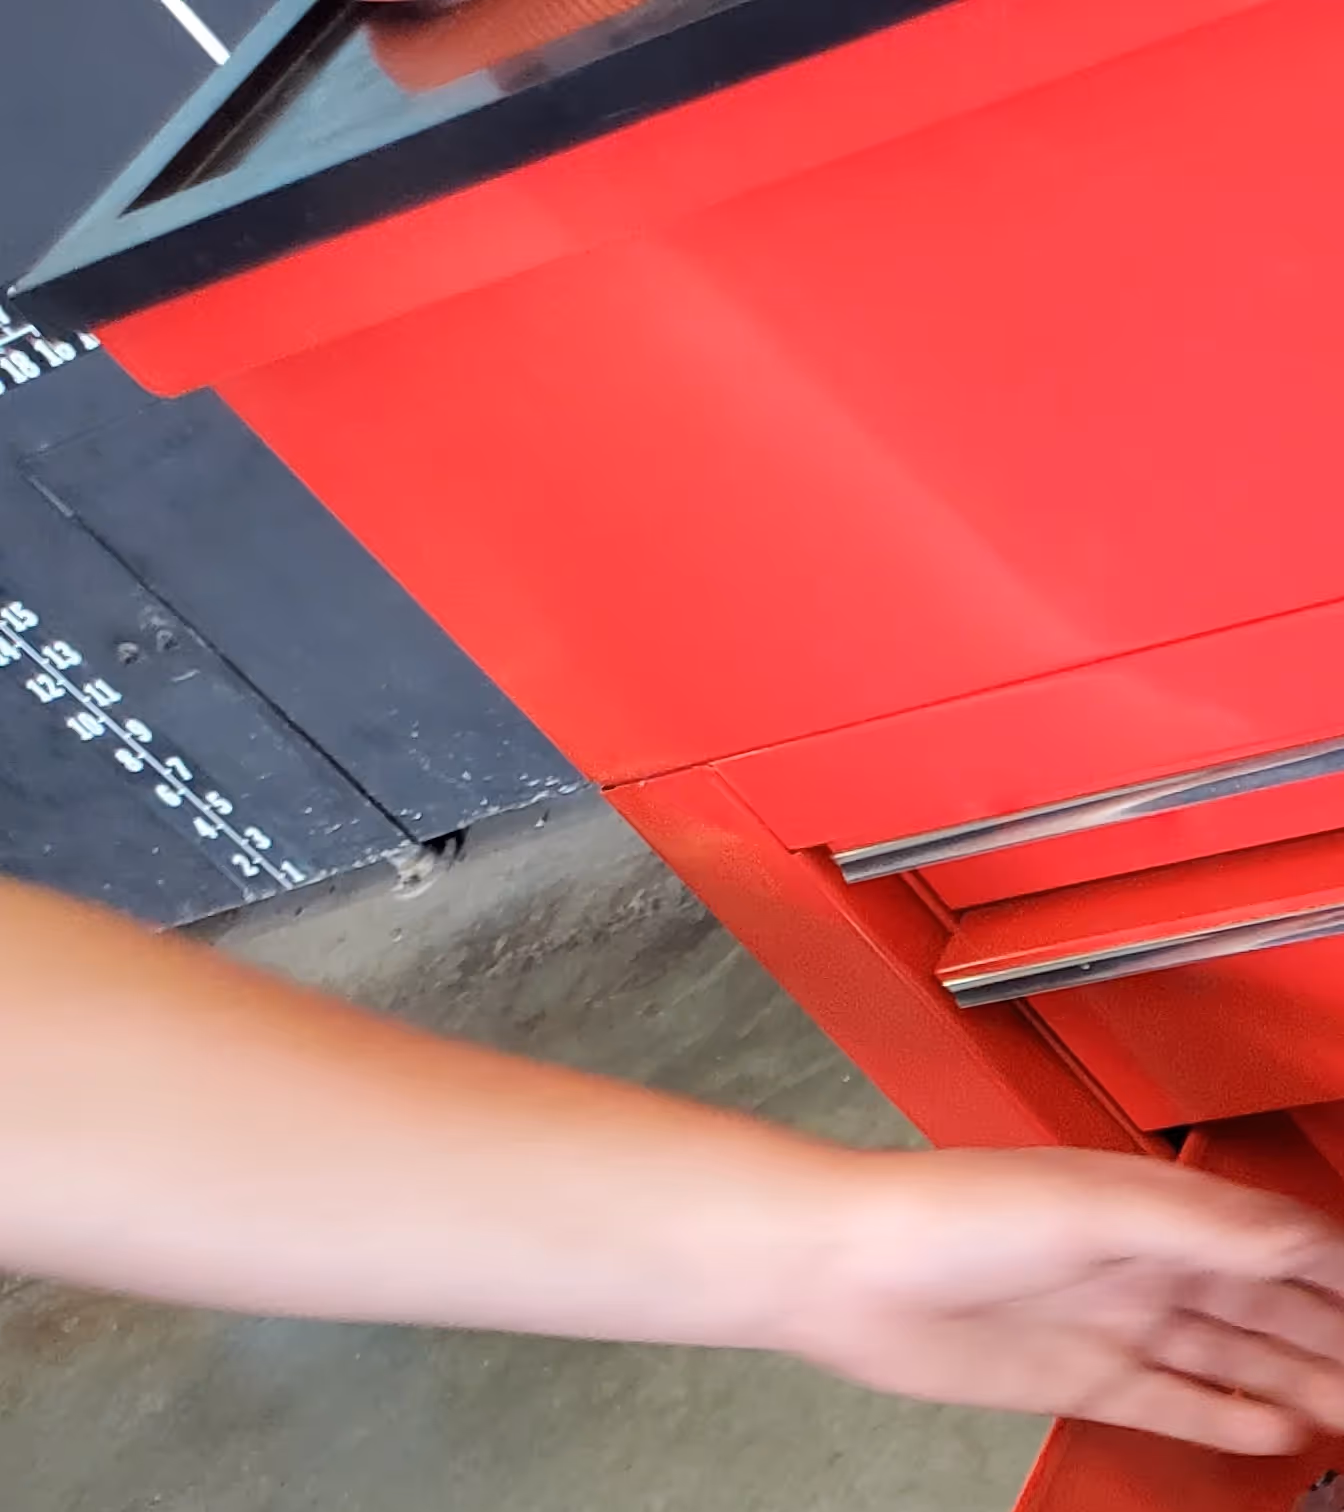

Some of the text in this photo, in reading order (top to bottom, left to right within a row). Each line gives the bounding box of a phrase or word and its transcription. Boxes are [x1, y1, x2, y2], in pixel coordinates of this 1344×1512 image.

[33, 339, 77, 368] 16
[0, 600, 39, 632] 15
[41, 640, 82, 670] 13
[26, 673, 66, 703] 12
[83, 678, 122, 707] 11
[66, 711, 105, 741] 10
[114, 748, 143, 773] 8
[165, 756, 193, 781] 7
[155, 784, 183, 807] 6
[205, 791, 233, 815] 5
[193, 816, 219, 839] 4
[244, 826, 272, 850] 3
[231, 854, 260, 877] 2
[280, 860, 306, 883] 1
